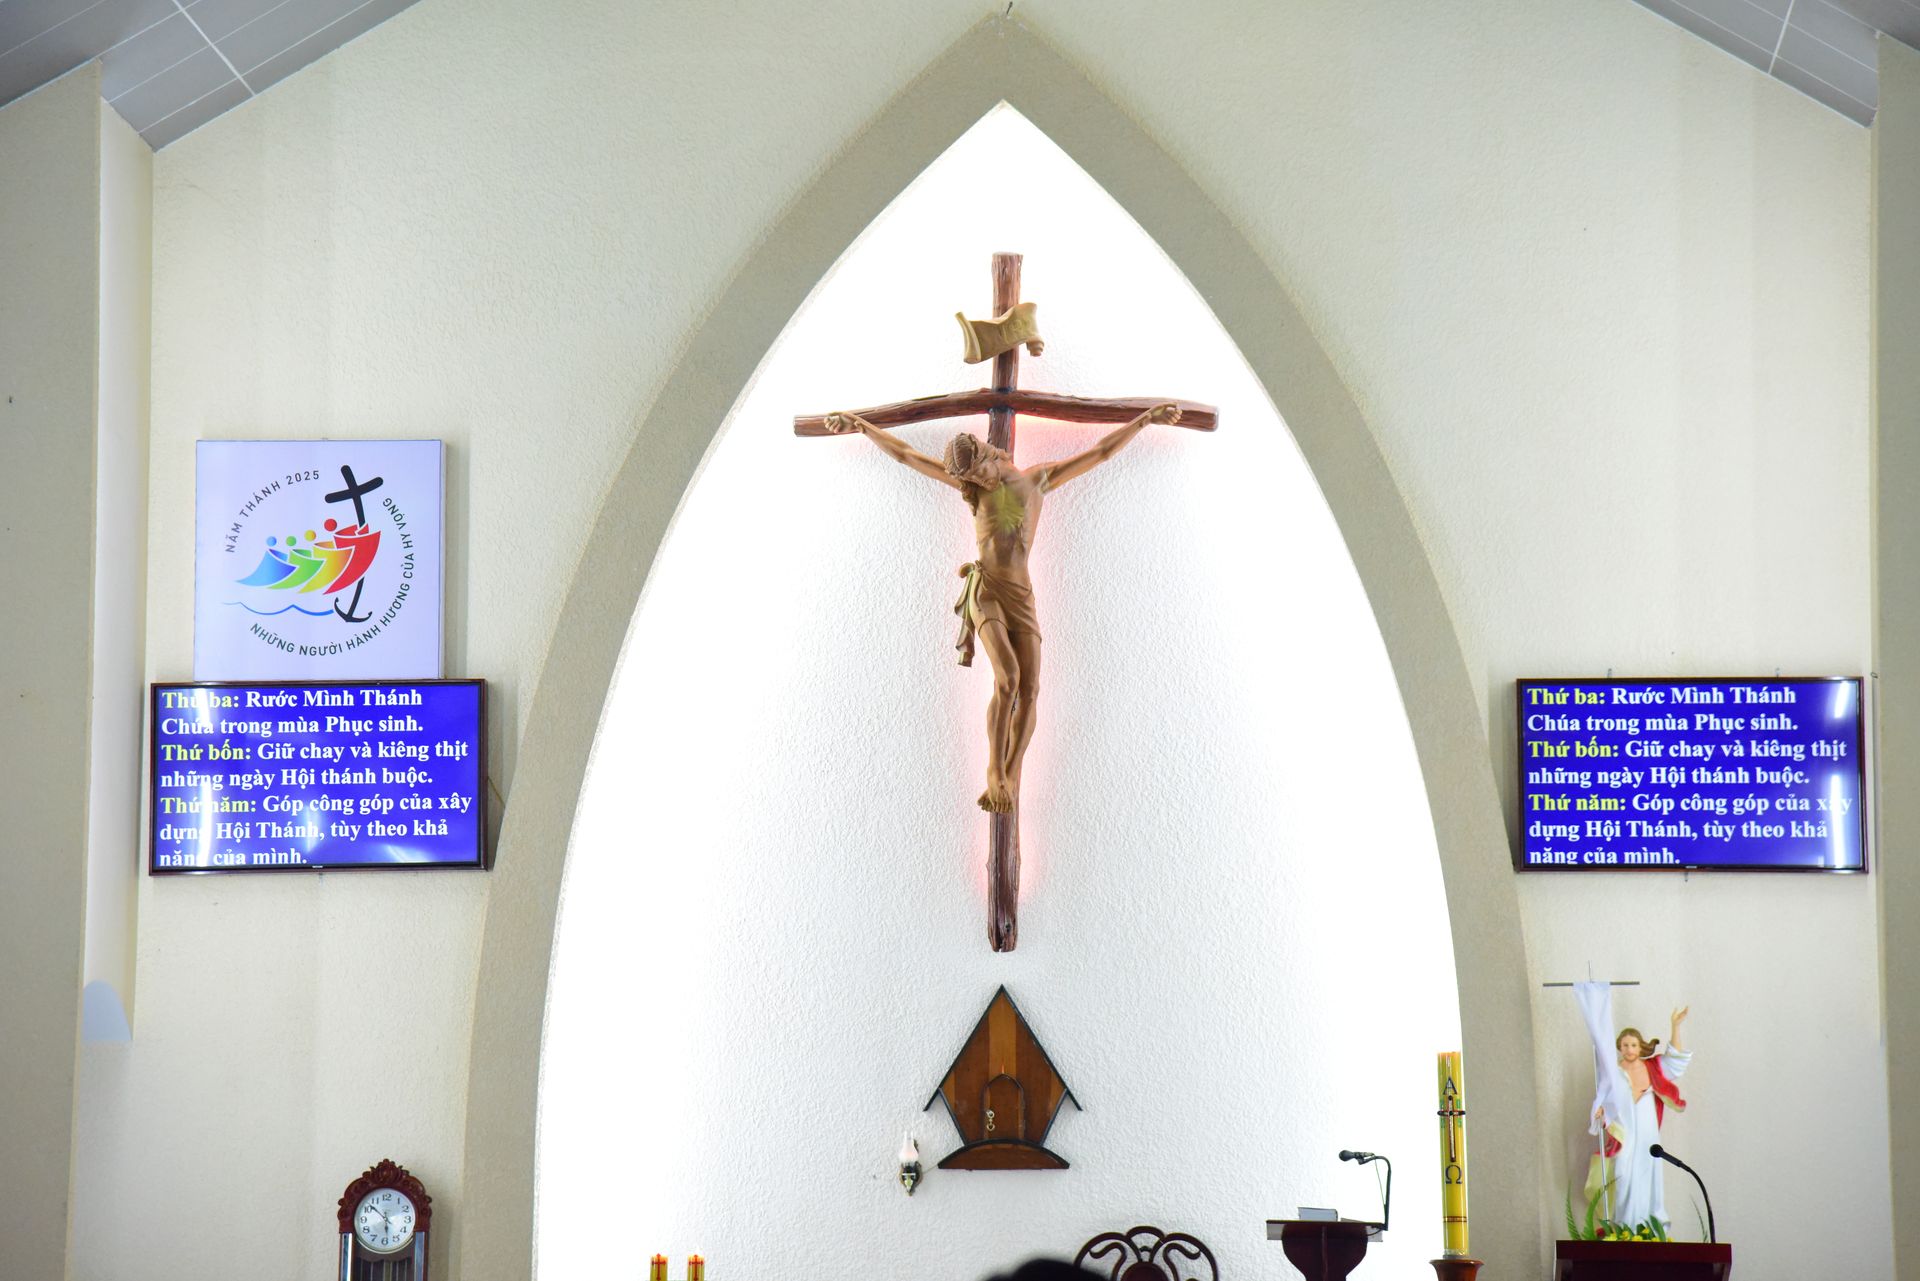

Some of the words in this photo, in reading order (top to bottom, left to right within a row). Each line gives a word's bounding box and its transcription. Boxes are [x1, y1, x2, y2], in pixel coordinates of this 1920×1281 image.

[224, 523, 243, 553] NĂM
[239, 481, 281, 519] THÁNH
[285, 470, 320, 486] 2025
[382, 497, 408, 530] VỌNG
[400, 533, 414, 549] HY
[402, 553, 414, 579] CỦA
[379, 582, 411, 628] HƯƠNG
[250, 623, 295, 654] NHỮNG
[347, 625, 382, 650] HÀNH
[299, 641, 343, 657] NGƯỜI
[209, 691, 240, 708] ba:
[245, 691, 297, 708] Rước
[303, 689, 355, 707] Mình
[360, 689, 423, 707] Thánh
[1527, 687, 1568, 706] Thứ
[1574, 687, 1606, 706] ba:
[1611, 687, 1666, 705] Rước
[1670, 687, 1725, 704] Mình
[1730, 686, 1797, 704] Thánh
[220, 720, 272, 737] trong
[278, 718, 319, 734] mùa
[325, 716, 373, 735] Phục
[378, 715, 423, 732] sinh.
[1527, 713, 1581, 732] Chúa
[1586, 716, 1640, 735] trong
[1645, 714, 1689, 731] mùa
[1694, 714, 1745, 734] Phục
[1750, 712, 1798, 731] sinh.
[161, 744, 203, 761] Thứ
[208, 739, 251, 761] bốn:
[257, 743, 295, 759] Giữ
[300, 743, 344, 762] chay
[350, 743, 372, 758] và
[378, 741, 429, 762] kiêng
[434, 740, 468, 761] thịt
[1528, 740, 1570, 759] Thứ
[1574, 735, 1619, 759] bốn:
[1625, 739, 1664, 757] Giữ
[1669, 740, 1716, 761] chay
[1722, 741, 1745, 757] và
[1751, 739, 1805, 760] kiêng
[1811, 739, 1847, 760] thịt
[161, 770, 223, 790] những
[229, 769, 276, 790] ngày
[281, 769, 315, 787] Hội
[321, 768, 376, 785] thánh
[382, 767, 433, 787] buộc.
[1528, 767, 1591, 788] những
[1597, 768, 1644, 788] ngày
[1649, 767, 1687, 786] Hội
[1692, 767, 1750, 785] thánh
[1756, 767, 1810, 788] buộc.
[262, 795, 304, 814] Góp
[309, 795, 353, 815] công
[359, 795, 394, 813] góp
[399, 793, 433, 810] của
[438, 792, 472, 813] xây
[1528, 793, 1571, 811] Thứ
[1576, 793, 1627, 811] năm:
[1632, 793, 1675, 814] Góp
[1680, 793, 1728, 814] công
[1733, 793, 1770, 814] góp
[1775, 792, 1811, 811] của
[160, 823, 209, 844] dựn
[216, 821, 251, 840] Hội
[256, 821, 325, 841] Thánh,
[330, 821, 361, 841] tùy
[367, 820, 407, 837] theo
[413, 818, 448, 836] khả
[1529, 820, 1579, 841] dựng
[1585, 820, 1621, 840] Hội
[1626, 820, 1698, 841] Thánh,
[1703, 820, 1737, 842] tùy
[1741, 820, 1785, 838] theo
[1790, 818, 1828, 838] khả
[159, 848, 207, 867] năn
[213, 848, 246, 865] của
[253, 848, 307, 865] mình.
[1583, 845, 1618, 865] của
[1624, 846, 1680, 864] mình.
[382, 1193, 392, 1201] 12
[364, 1205, 372, 1213] 10
[402, 1205, 409, 1213] 2
[381, 1237, 389, 1245] 6
[392, 1234, 400, 1242] 5
